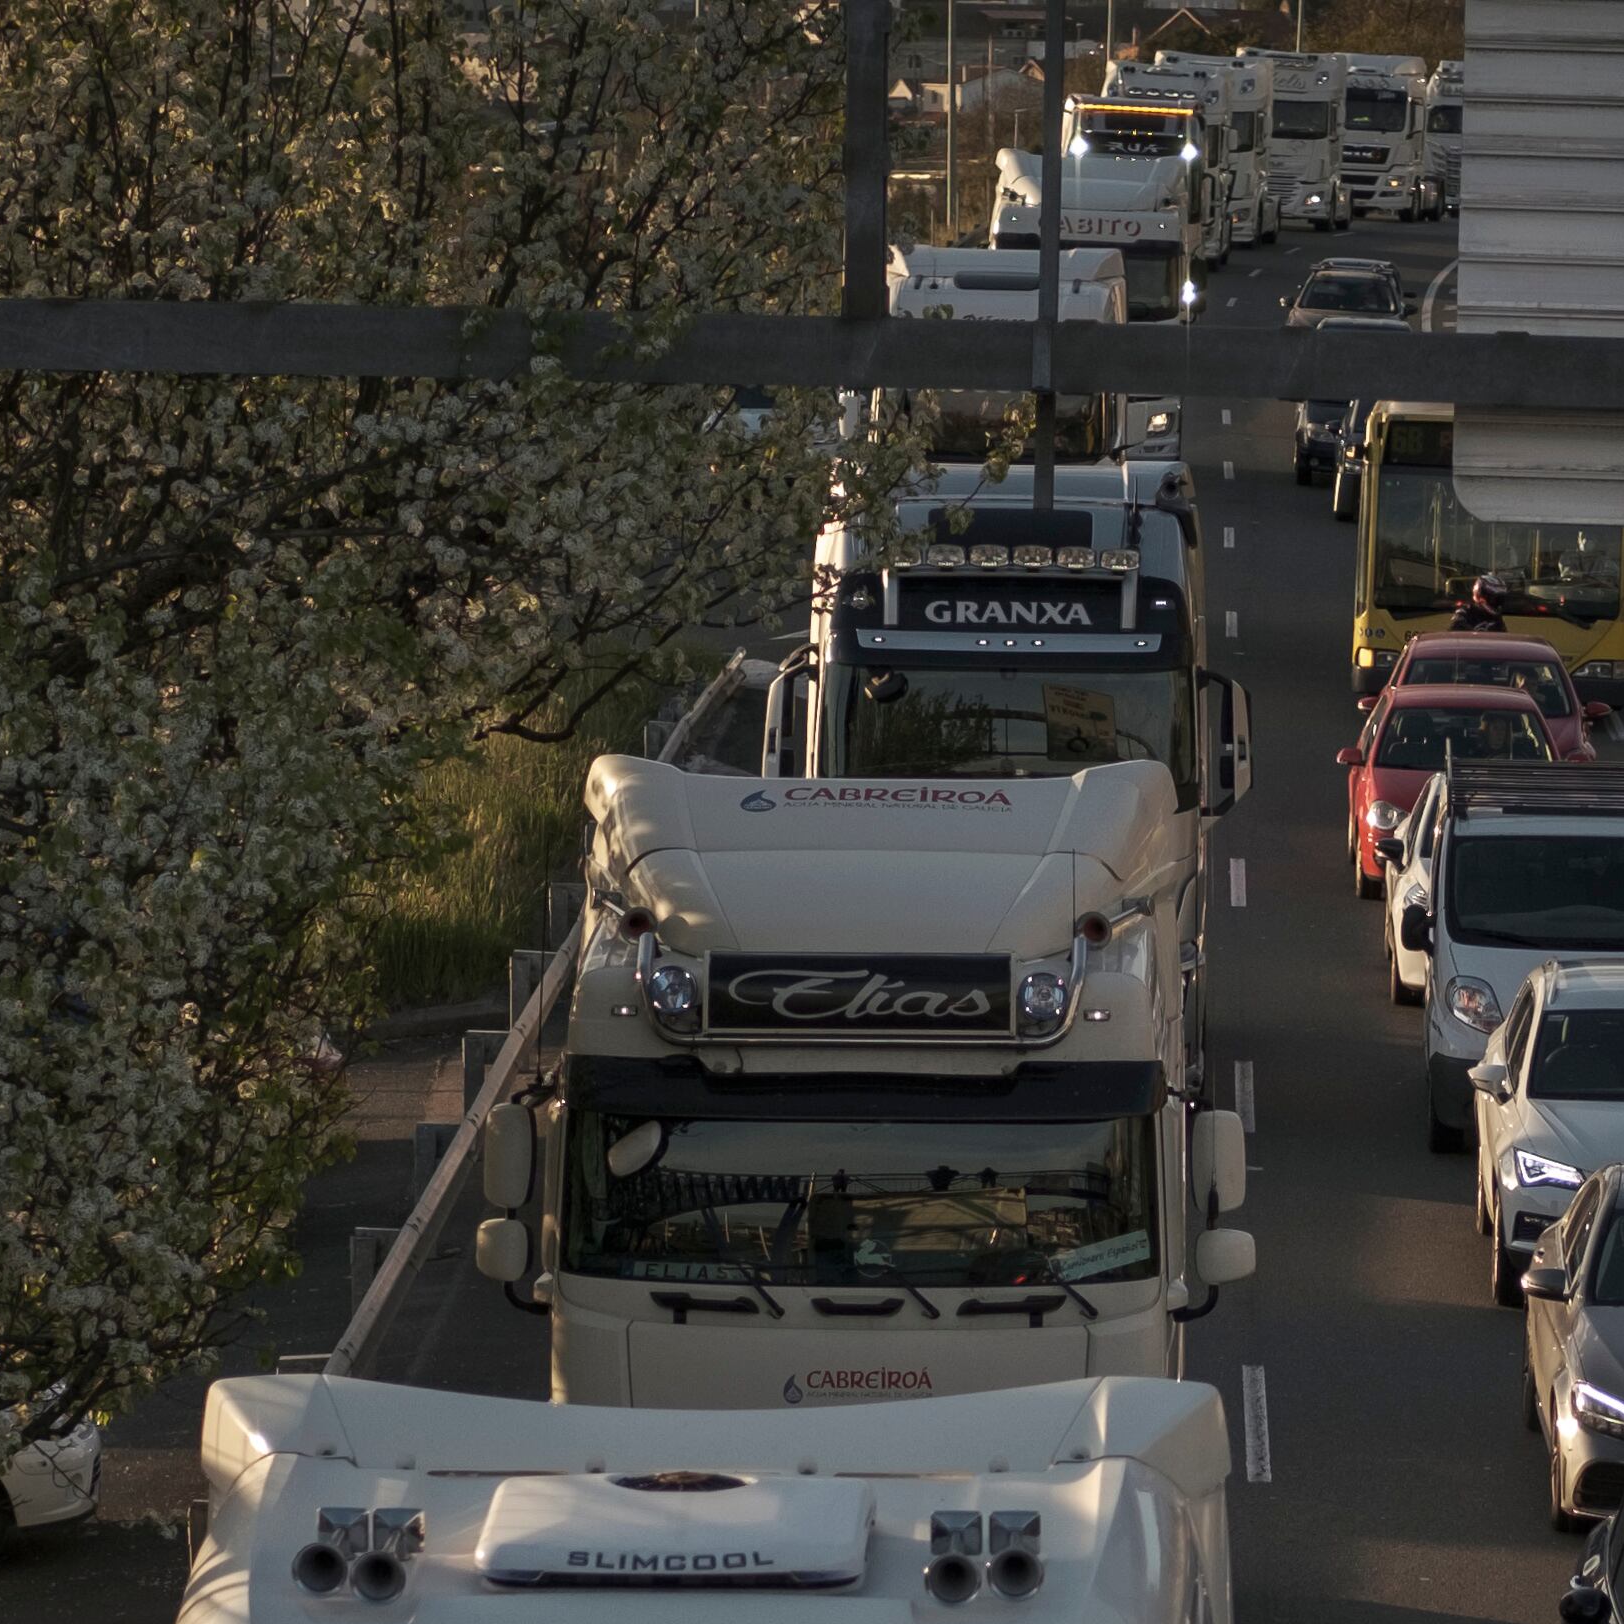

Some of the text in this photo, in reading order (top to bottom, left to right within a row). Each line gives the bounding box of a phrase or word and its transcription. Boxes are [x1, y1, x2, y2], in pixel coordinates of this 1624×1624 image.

[1038, 215, 1142, 238] ABITO
[925, 599, 1093, 626] GRANXA
[645, 1263, 729, 1280] ELIAS
[567, 1550, 774, 1572] SLIMCOOL
